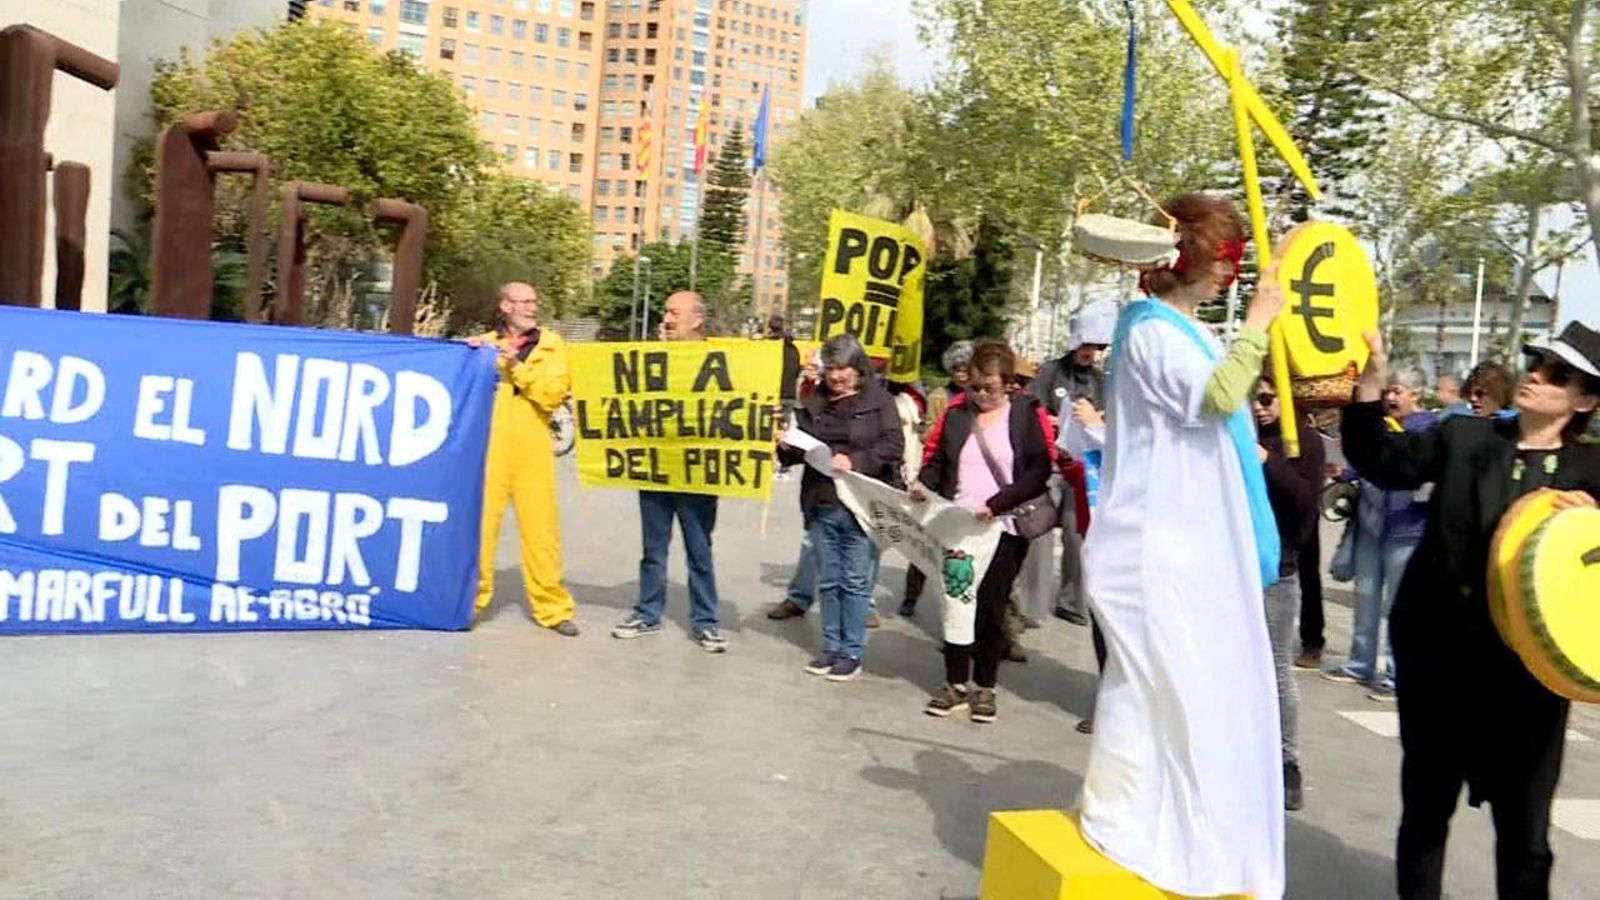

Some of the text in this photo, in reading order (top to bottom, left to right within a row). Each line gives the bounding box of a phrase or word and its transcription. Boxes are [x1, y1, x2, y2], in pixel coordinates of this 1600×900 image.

[613, 351, 734, 395] NO A
[134, 374, 206, 446] EL
[227, 351, 452, 467] NORD
[577, 393, 775, 442] L'AMPLIACIÓ
[605, 448, 773, 489] DEL PORT
[100, 492, 202, 551] DEL
[217, 485, 449, 592] PORT
[0, 570, 196, 623] MARFULL
